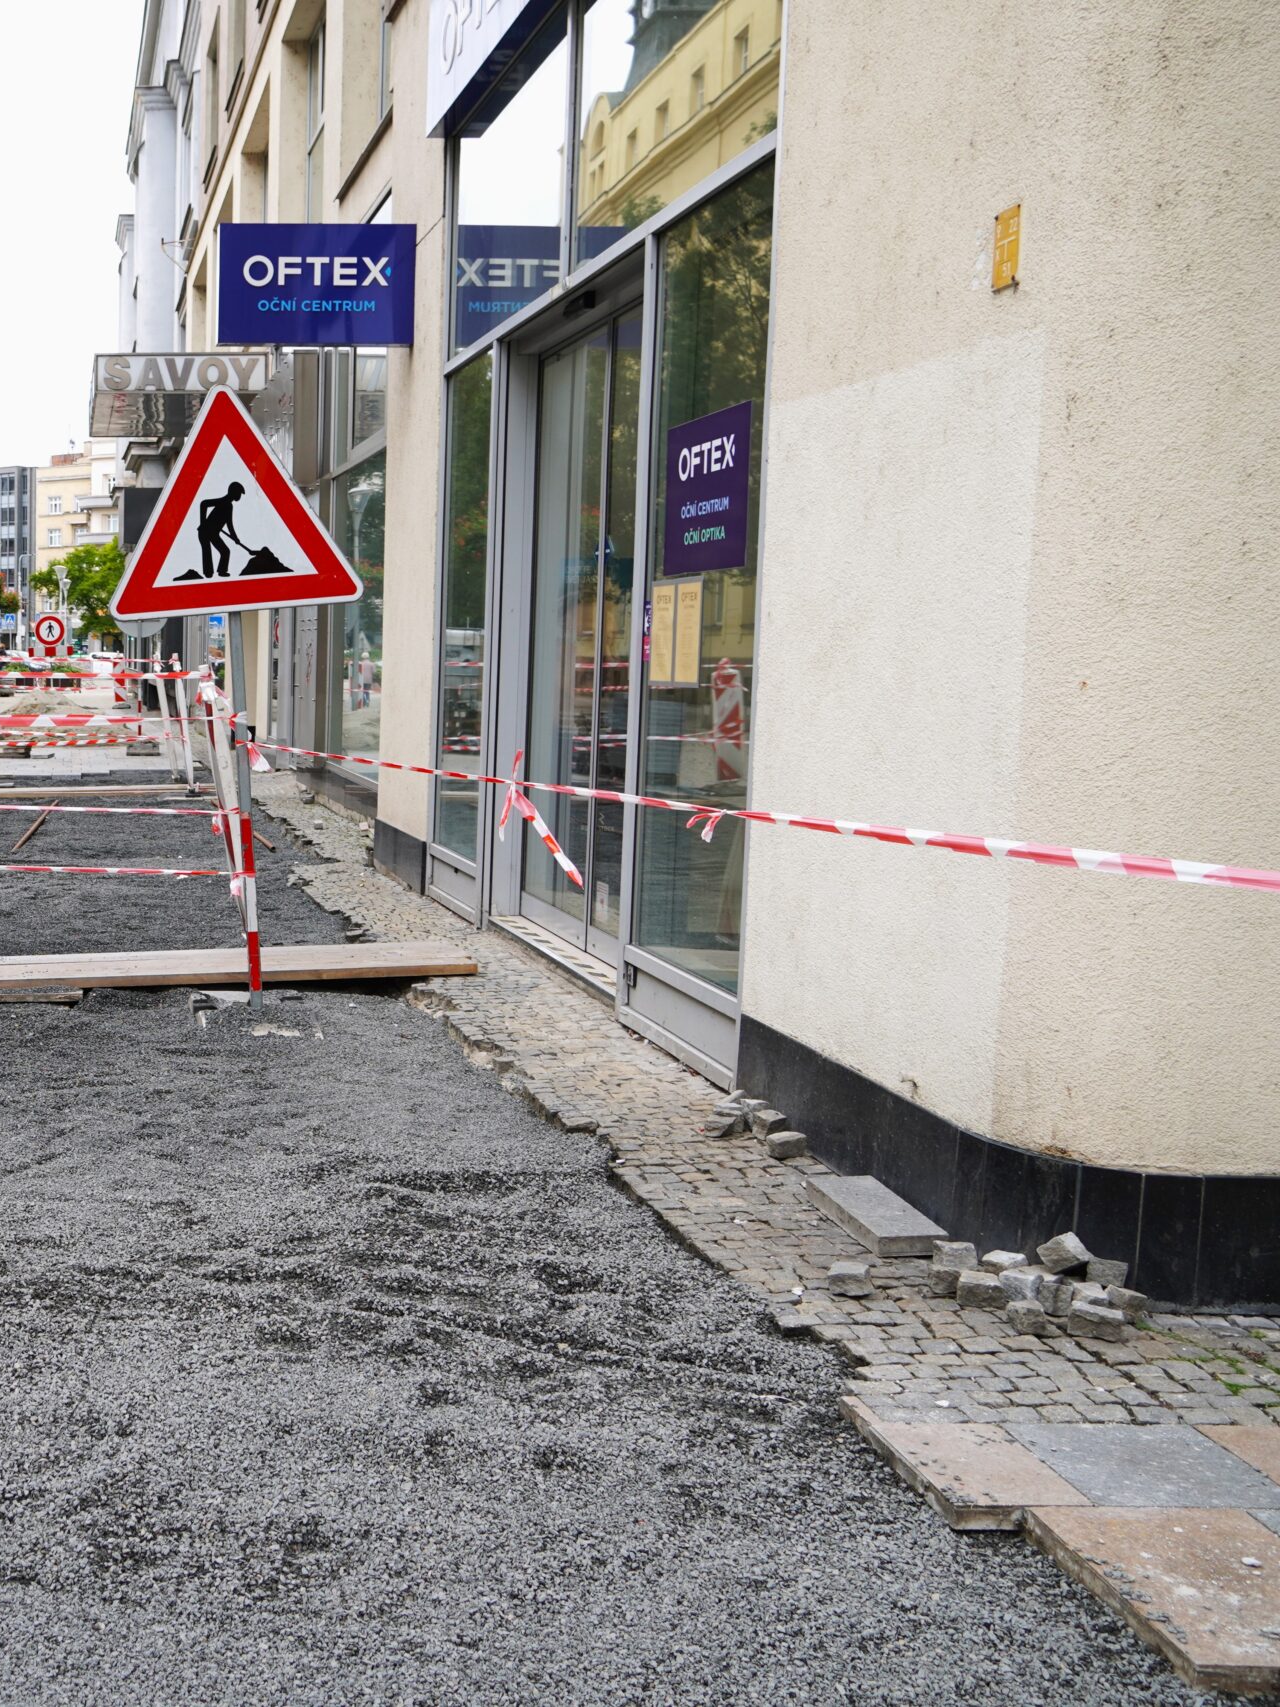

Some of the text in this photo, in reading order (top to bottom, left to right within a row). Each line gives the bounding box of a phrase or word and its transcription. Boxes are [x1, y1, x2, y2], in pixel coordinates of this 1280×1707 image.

[242, 255, 390, 288] OFTEX
[257, 296, 377, 313] OČNÍ CENTRUM
[104, 356, 260, 391] SAVOY
[678, 434, 736, 482] OFTEX
[681, 496, 730, 519] OČNÍ CENTRUM
[683, 526, 726, 546] OČNÍ OPTIKA
